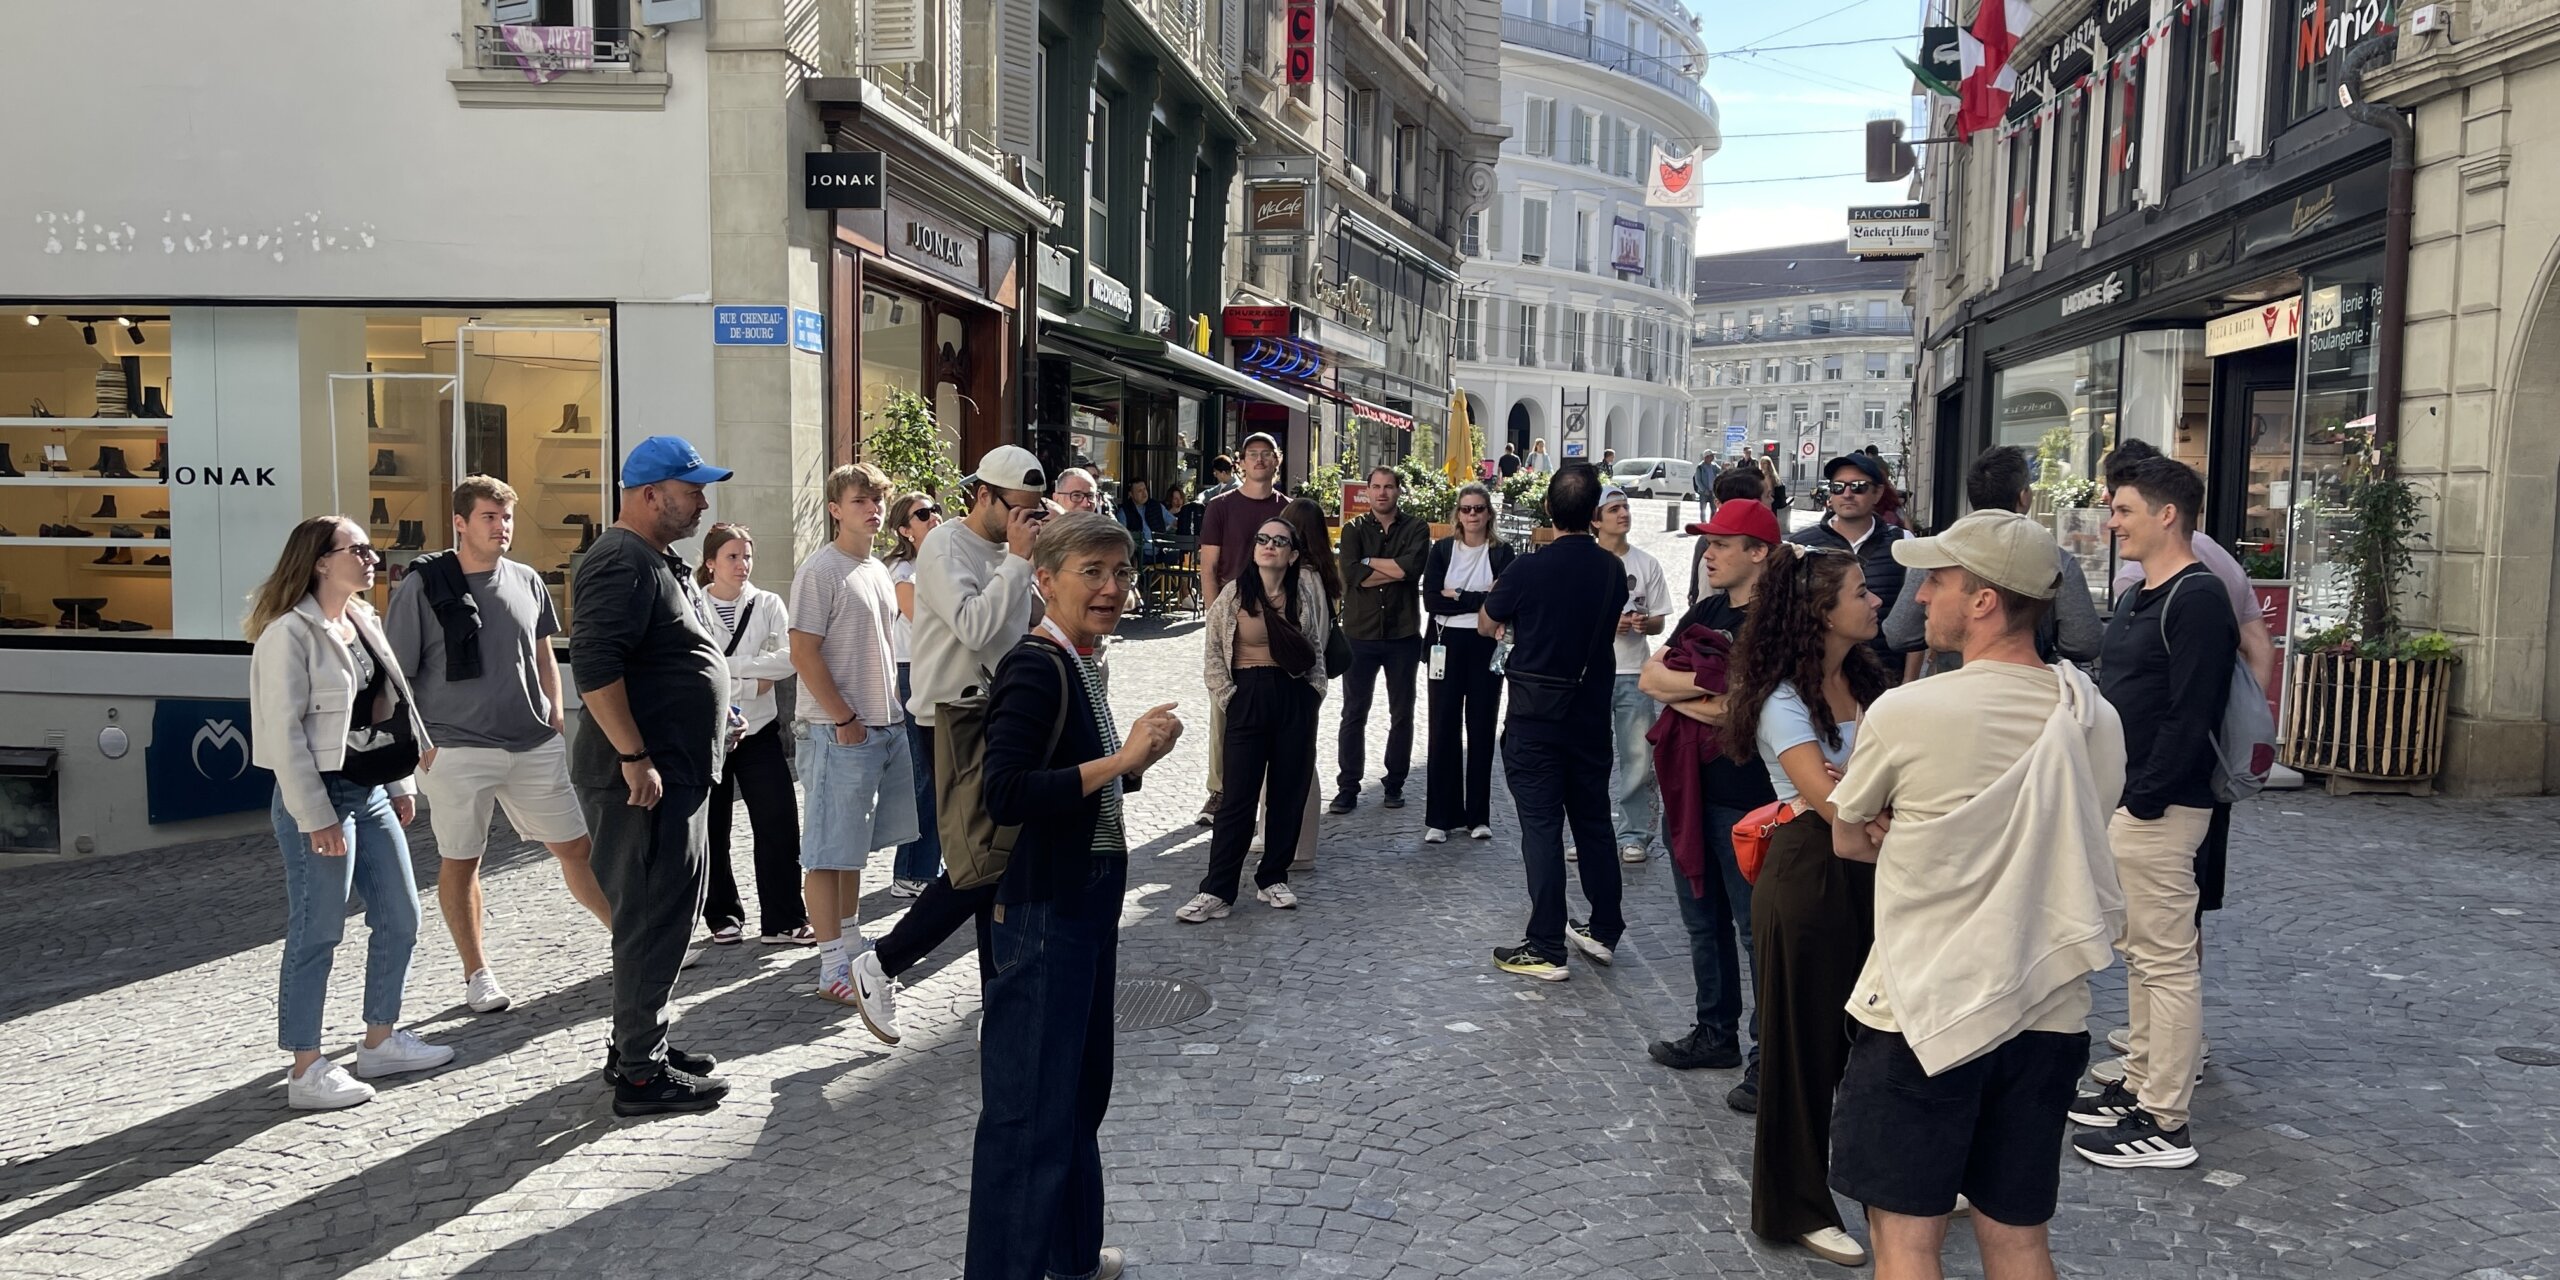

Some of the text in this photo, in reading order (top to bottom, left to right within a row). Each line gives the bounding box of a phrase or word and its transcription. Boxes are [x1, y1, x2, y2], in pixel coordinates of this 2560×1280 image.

[547, 28, 586, 51] AVS 21
[2297, 0, 2380, 71] Mario
[2009, 61, 2042, 107] IZZA
[2062, 16, 2095, 61] BASTA
[810, 174, 876, 187] JONAK
[1257, 196, 1303, 219] McCafé
[1854, 208, 1919, 220] FALCONERI
[914, 222, 965, 267] JONAK
[1092, 278, 1132, 315] McDonald's
[719, 312, 784, 325] RUE CHENEAU-
[730, 327, 774, 339] DE-BOURG
[2311, 325, 2364, 352] Boulangerie
[158, 466, 276, 486] JONAK
